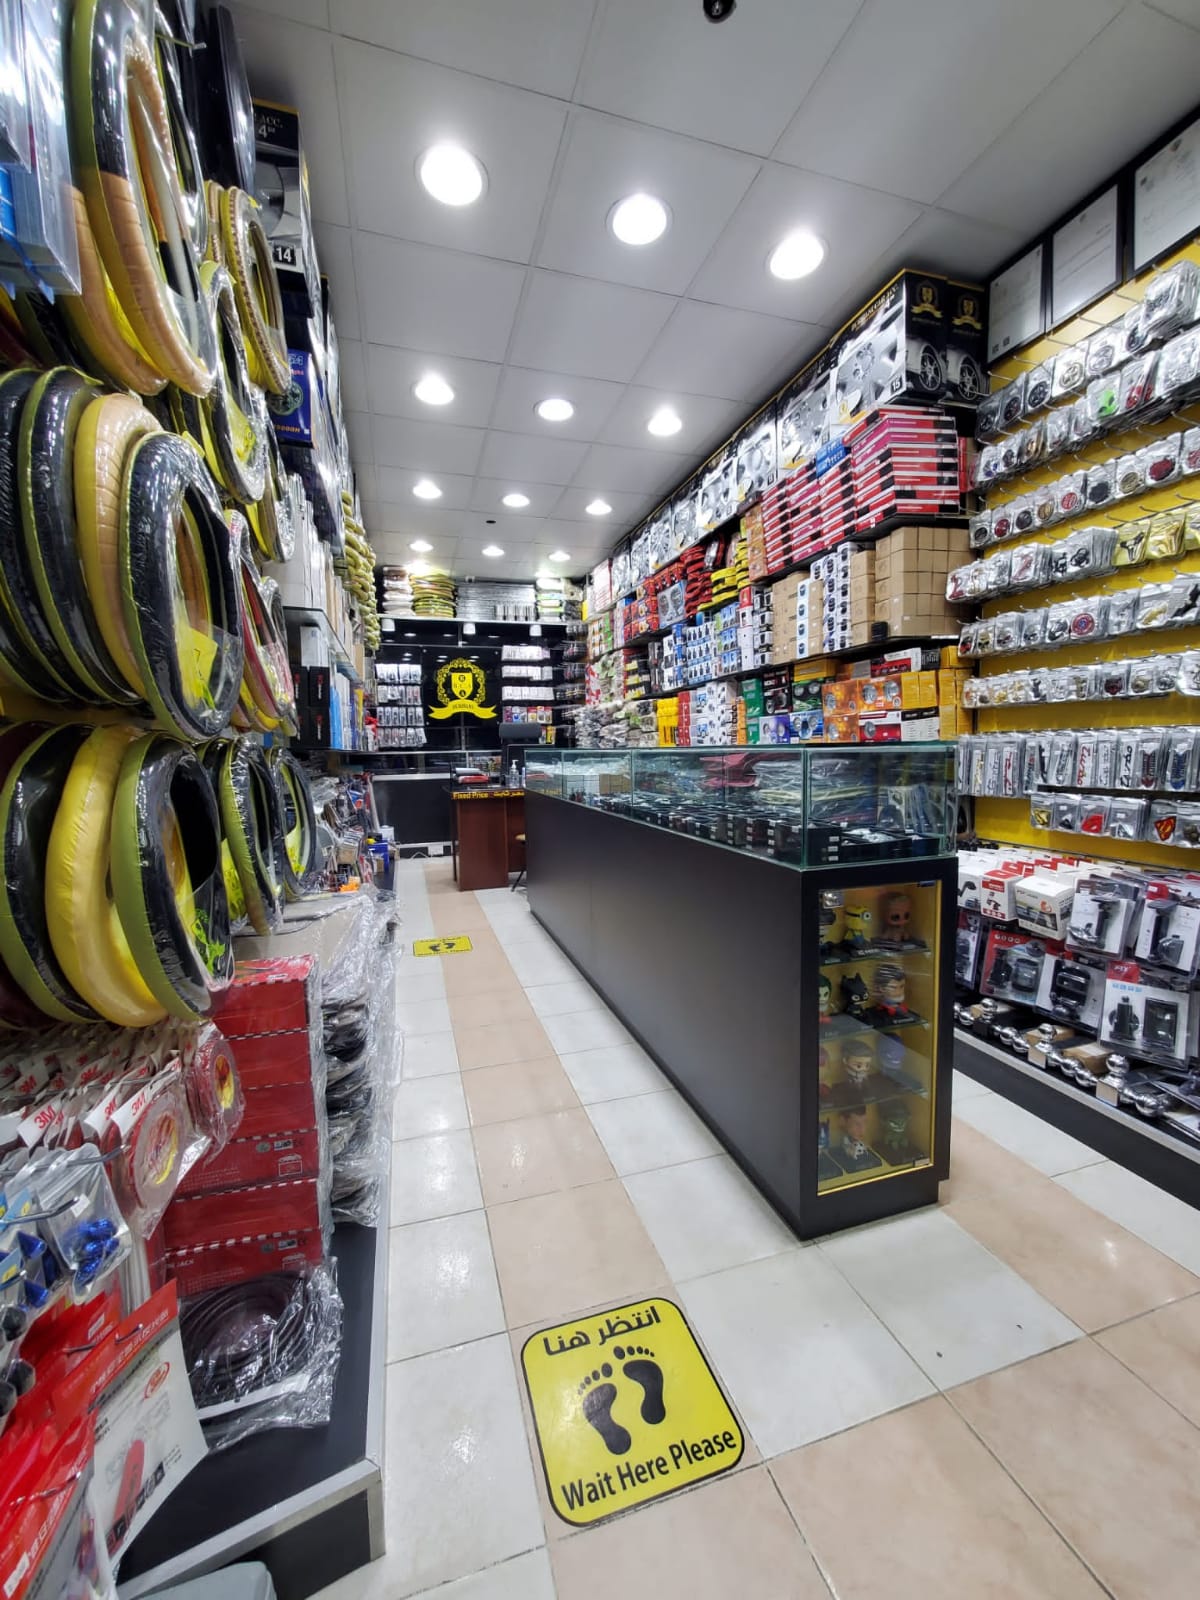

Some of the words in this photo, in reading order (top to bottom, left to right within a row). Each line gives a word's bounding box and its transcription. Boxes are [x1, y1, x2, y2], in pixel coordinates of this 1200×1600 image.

[275, 247, 292, 263] 14
[891, 379, 901, 391] 15
[453, 791, 471, 799] Fixed
[472, 791, 489, 799] Price
[19, 1074, 37, 1094] 3M
[131, 1091, 146, 1116] 3M
[34, 1104, 56, 1130] 3M
[598, 1306, 660, 1345] انتظر
[542, 1331, 591, 1357] هنا
[561, 1472, 616, 1511] Wait
[616, 1456, 670, 1491] Here
[669, 1430, 737, 1470] Please
